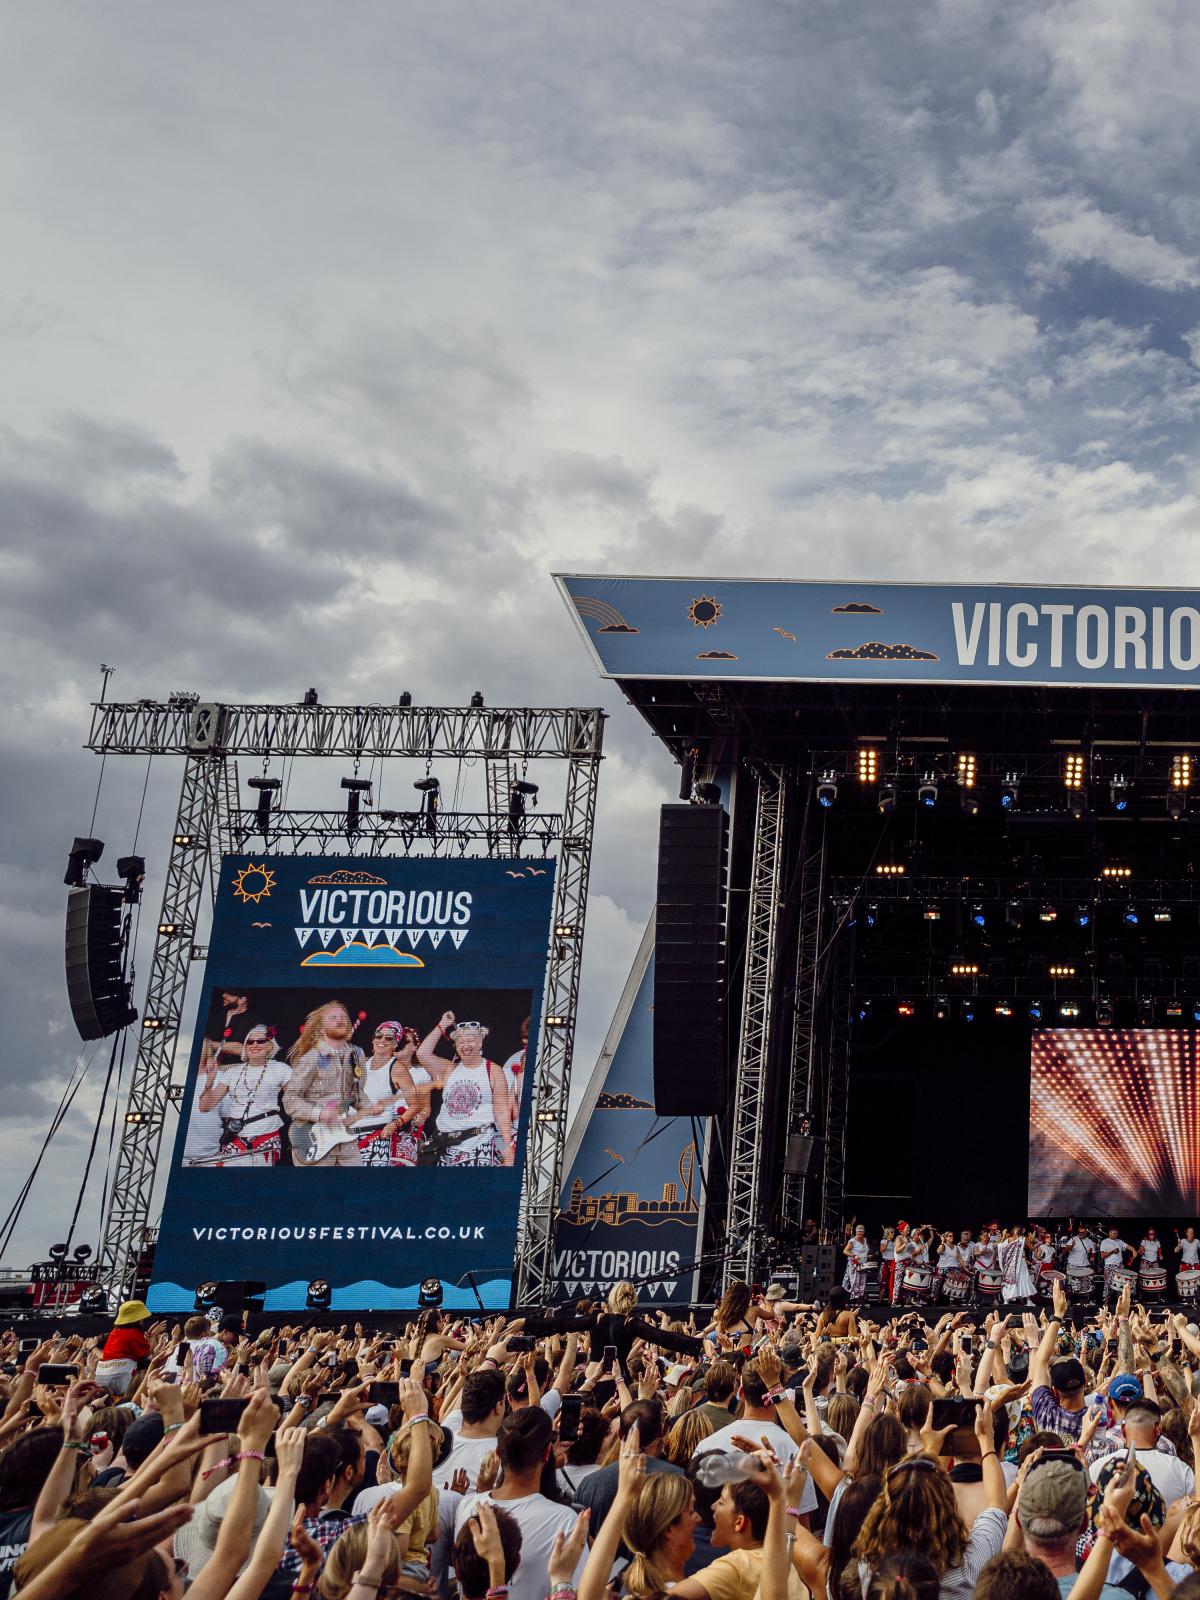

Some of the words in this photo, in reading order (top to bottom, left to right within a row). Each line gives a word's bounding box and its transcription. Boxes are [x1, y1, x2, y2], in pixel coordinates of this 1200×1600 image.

[300, 889, 471, 924] VICTORIOUS
[299, 929, 463, 944] FESTIVAL
[192, 1226, 485, 1240] VICTORIOUSFESTIVAL.CO.UK
[551, 1249, 680, 1279] VICTORIOUS
